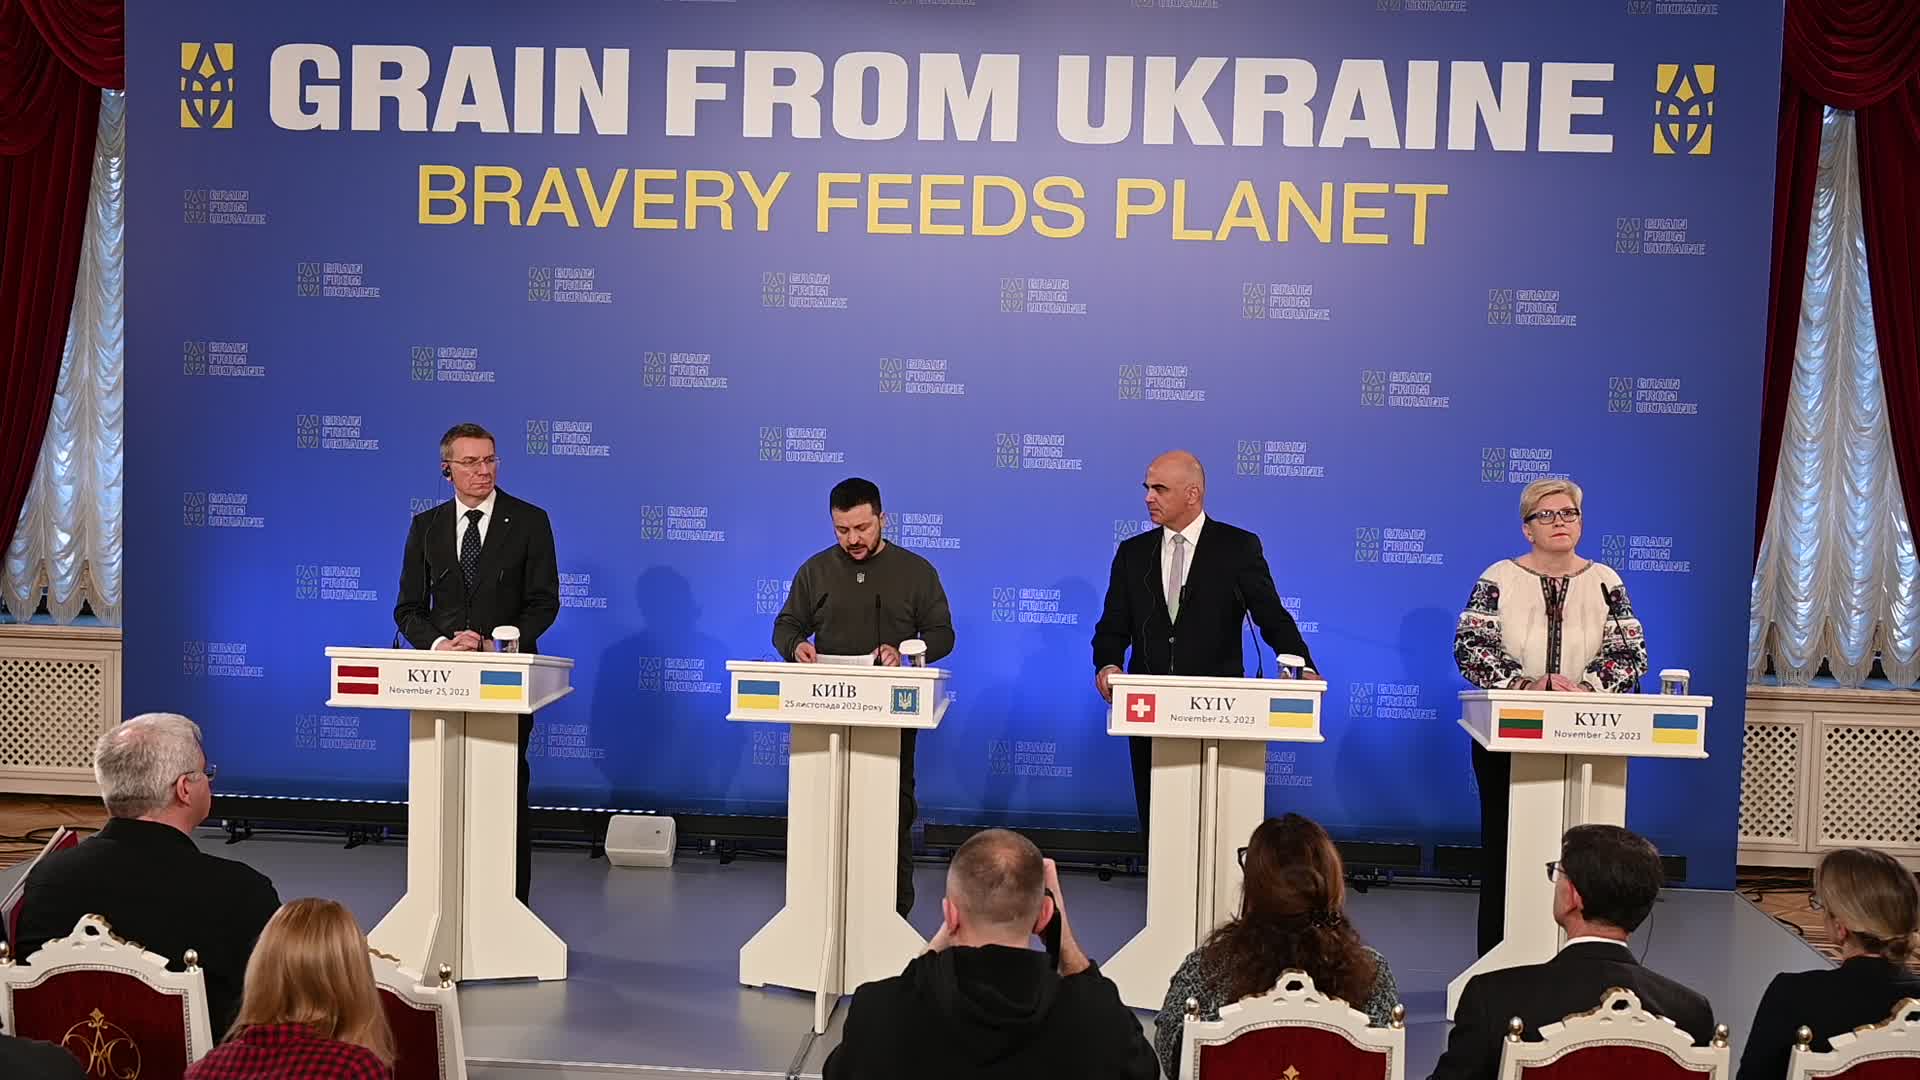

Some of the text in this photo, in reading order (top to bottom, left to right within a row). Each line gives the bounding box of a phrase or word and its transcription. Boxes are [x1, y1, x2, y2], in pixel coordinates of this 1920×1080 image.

[270, 44, 1613, 152] GRAIN FROM UKRAINE
[419, 165, 1449, 246] BRAVERY FEEDS PLANET
[560, 573, 590, 584] RAIN
[560, 585, 589, 596] ROM
[408, 668, 452, 683] KYIV
[389, 686, 470, 697] November 25, 2023
[812, 682, 857, 698] КИЇВ
[784, 699, 883, 713] 25 листопада 2023 року
[1190, 696, 1236, 711] KYIV
[1170, 714, 1256, 725] November 25, 2023
[1575, 712, 1622, 727] KYIV
[1554, 729, 1641, 741] November 25, 2023
